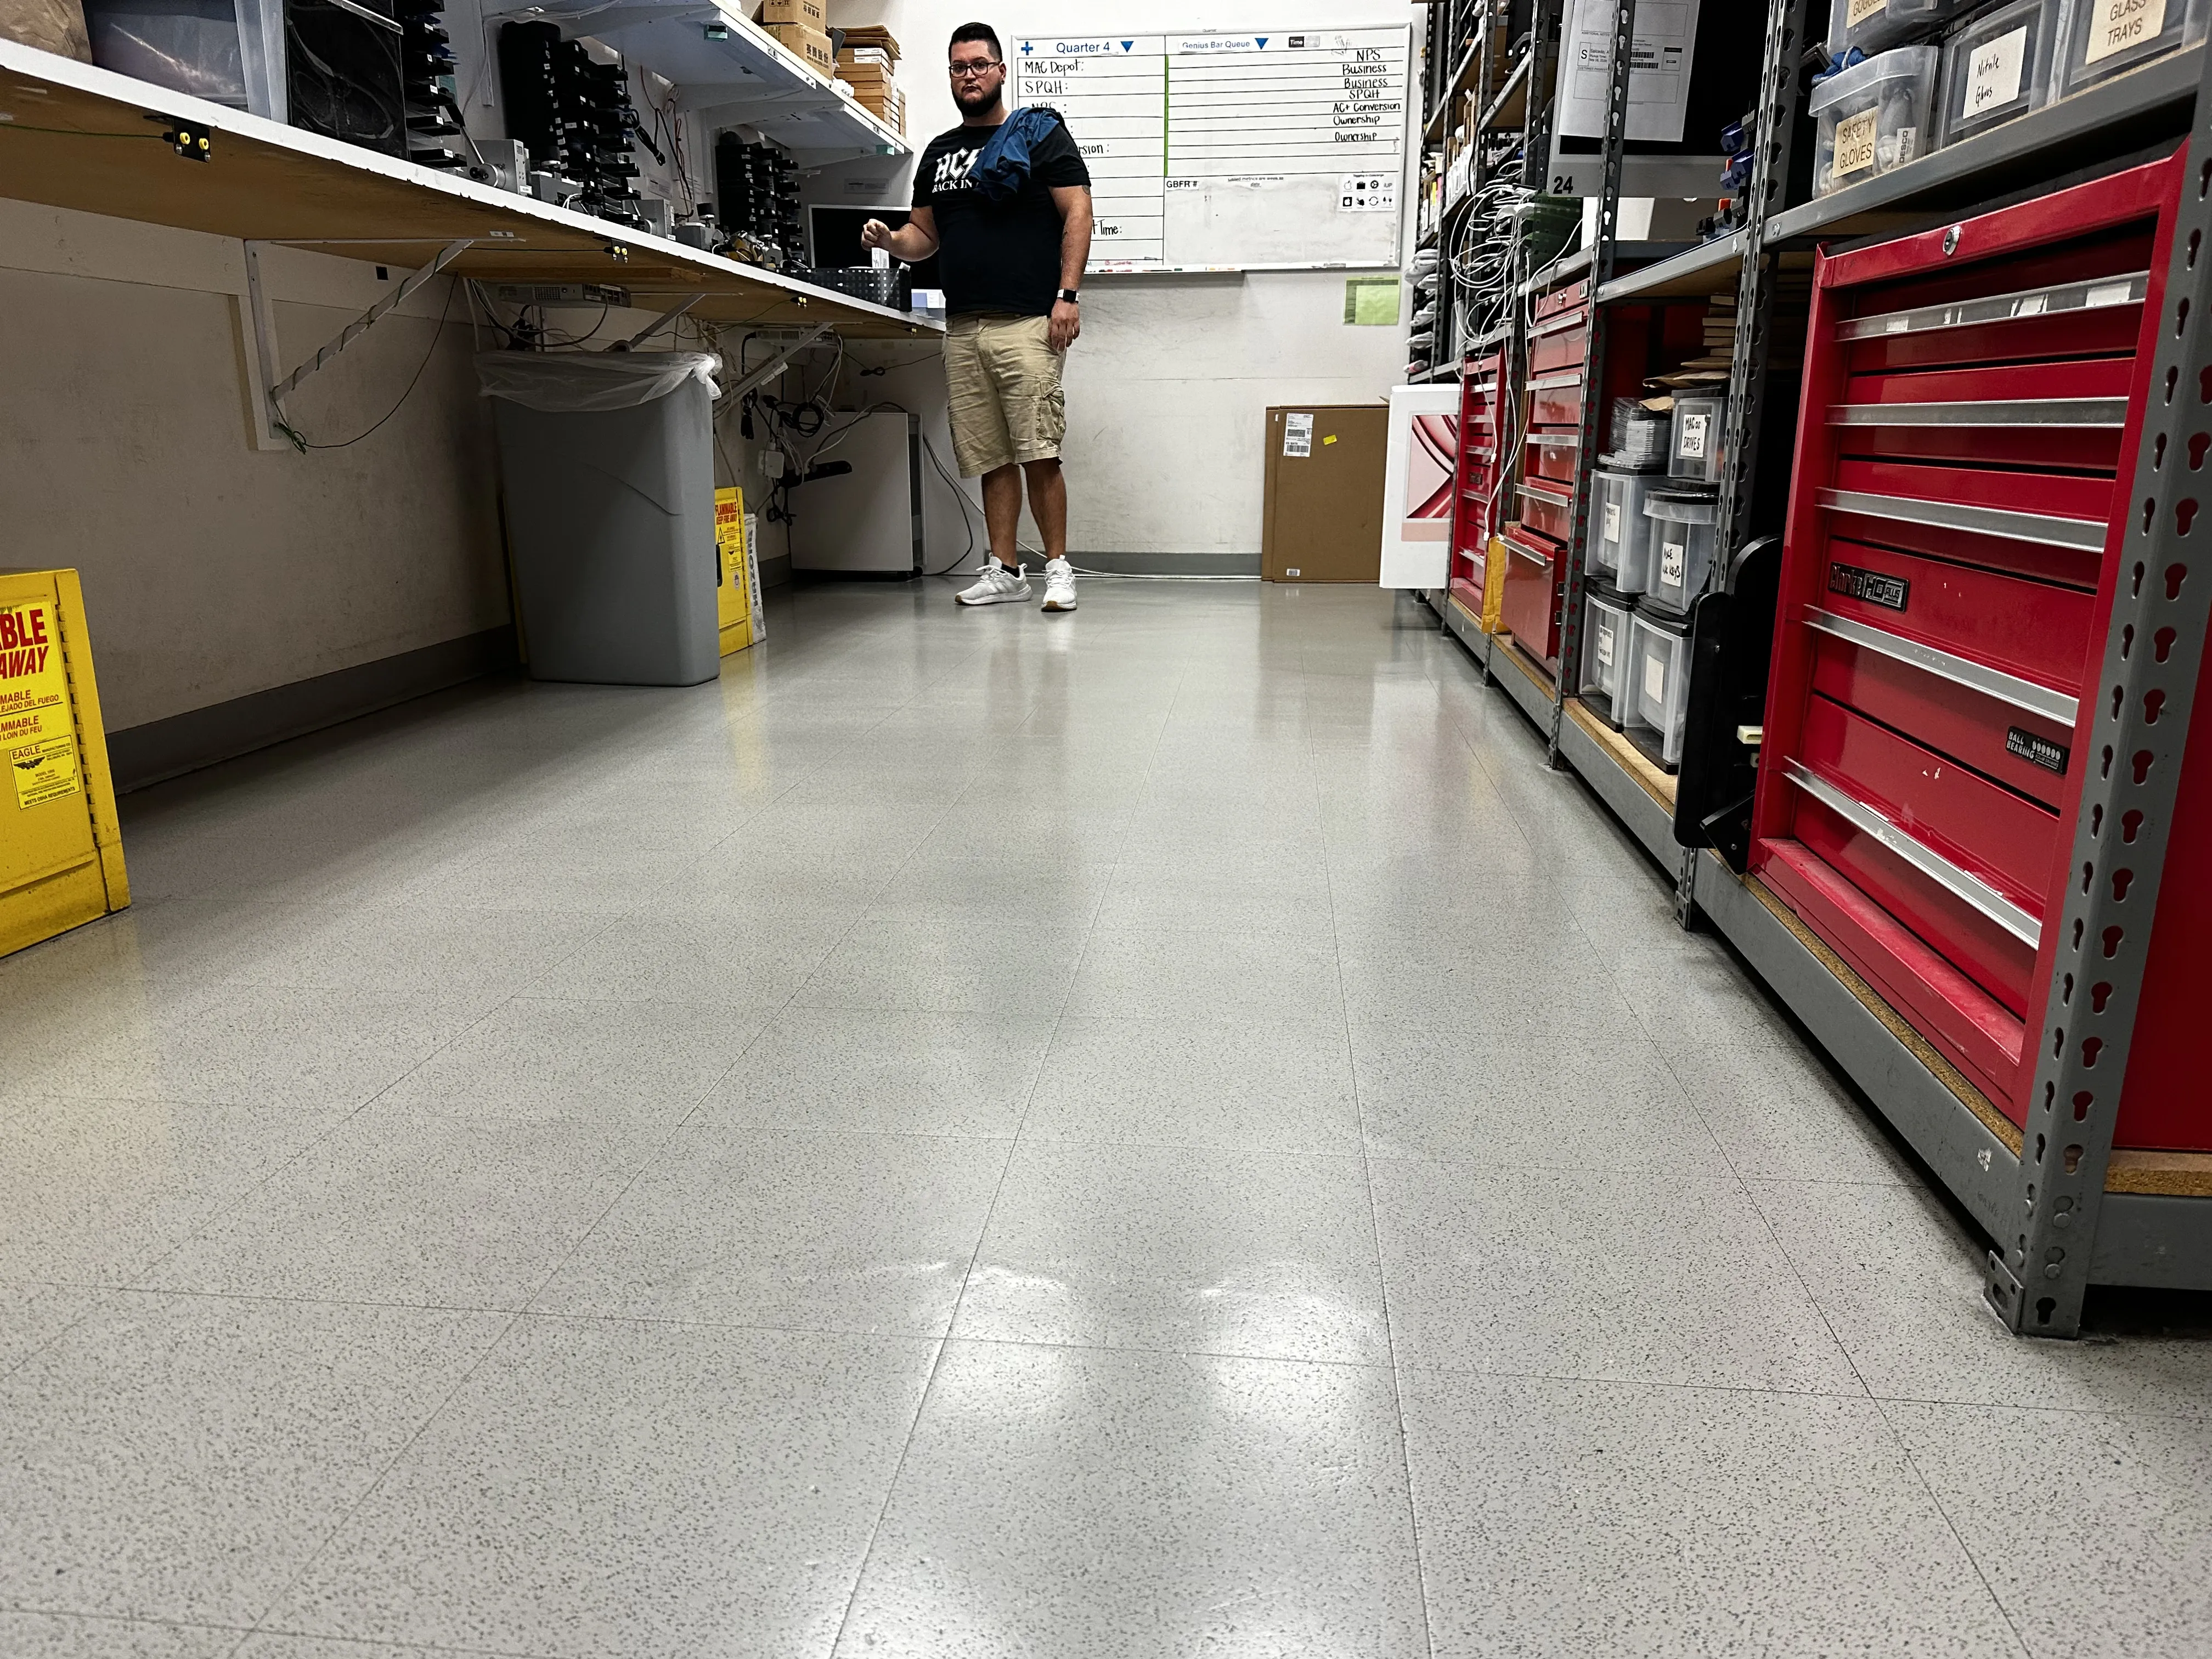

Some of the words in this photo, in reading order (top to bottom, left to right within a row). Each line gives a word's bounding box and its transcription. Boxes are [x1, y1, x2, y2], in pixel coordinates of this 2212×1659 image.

[2110, 0, 2146, 21] GLASS
[2108, 18, 2142, 46] TRAYS
[1057, 42, 1099, 53] Quarter
[1103, 42, 1110, 50] 4
[1357, 49, 1380, 61] NPS
[1581, 49, 1587, 59] S
[1025, 61, 1047, 74] MAC
[1342, 64, 1387, 75] Business
[1977, 54, 1999, 78] Nitrile
[1345, 78, 1388, 88] Business
[1349, 89, 1380, 99] SPQH
[1976, 86, 1993, 108] Gloves
[1333, 103, 1350, 113] AC+
[1353, 103, 1400, 112] Conversion
[1333, 115, 1380, 126] Ownership
[1335, 132, 1377, 142] Ownership
[1842, 116, 1874, 144] SAFETY
[1899, 131, 1908, 163] DESCO
[1840, 143, 1872, 169] GLOVES
[932, 180, 958, 193] BACK
[960, 179, 972, 189] IN
[1553, 176, 1573, 194] 24
[715, 502, 737, 516] FLAMMABLE
[0, 609, 48, 651] BLE
[0, 702, 22, 713] EJADO
[38, 695, 59, 704] FUEGO
[0, 715, 38, 732] MMABLE
[3, 731, 18, 740] LOIN
[20, 728, 28, 736] DU
[30, 725, 42, 733] FEU
[2008, 731, 2024, 745] BALL
[12, 745, 41, 760] EAGLE
[2006, 740, 2035, 759] BEARING
